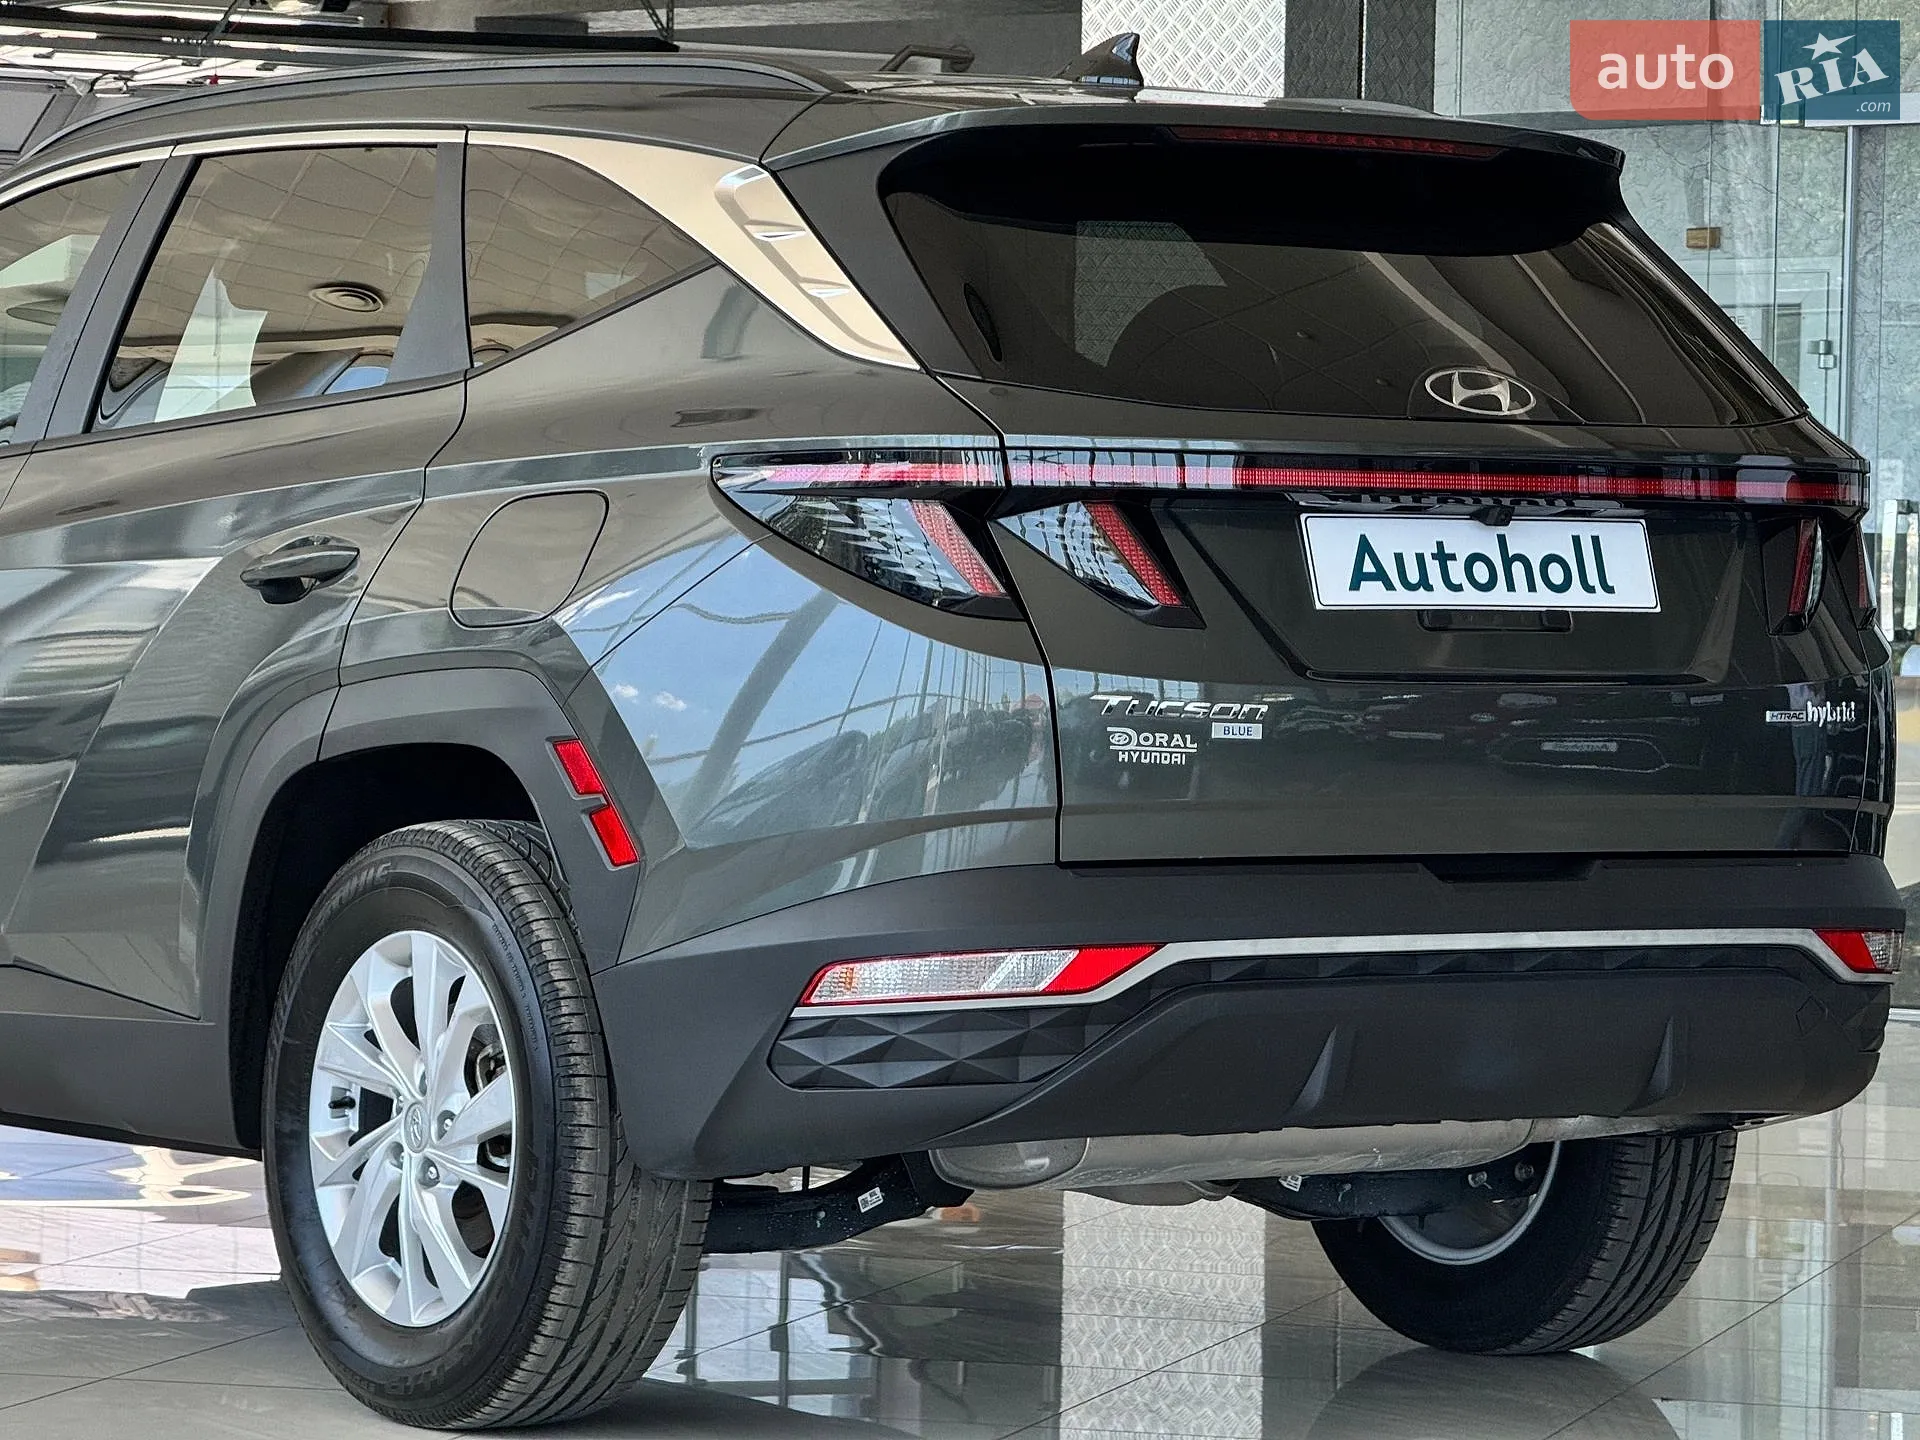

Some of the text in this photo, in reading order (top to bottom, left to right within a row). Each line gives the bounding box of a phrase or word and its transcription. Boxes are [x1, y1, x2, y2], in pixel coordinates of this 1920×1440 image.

[1348, 533, 1616, 595] Autoholl
[1769, 700, 1856, 728] HTRAC hybrid
[1106, 726, 1198, 749] DORAL
[1223, 724, 1253, 737] BLUE
[1118, 751, 1186, 766] HYUNDAI
